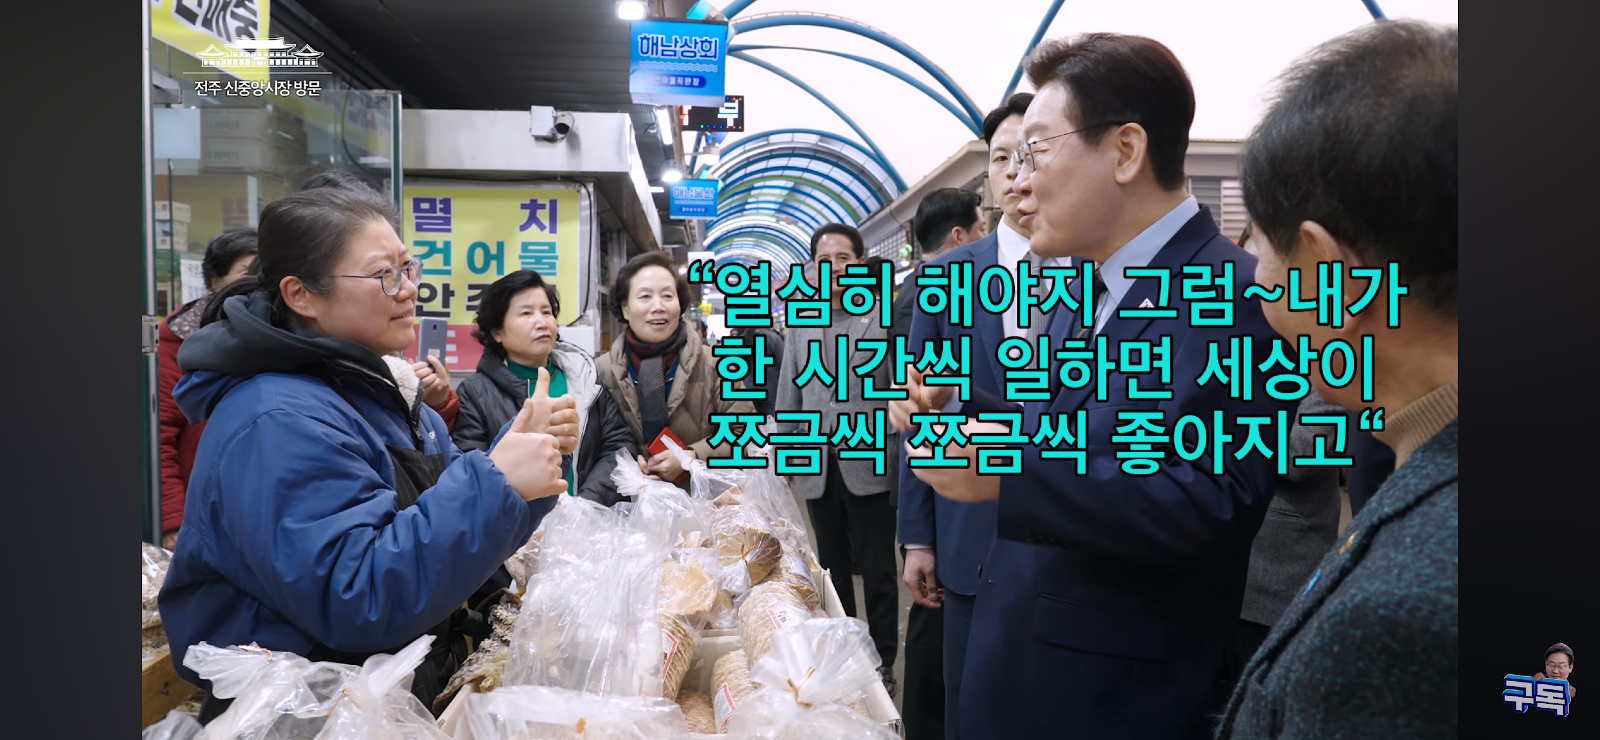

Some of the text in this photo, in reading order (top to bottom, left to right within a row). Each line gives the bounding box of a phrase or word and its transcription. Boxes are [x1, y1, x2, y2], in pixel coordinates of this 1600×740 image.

[638, 33, 719, 60] 해남상회
[673, 186, 716, 199] 해남물산
[412, 240, 559, 277] 건어물
